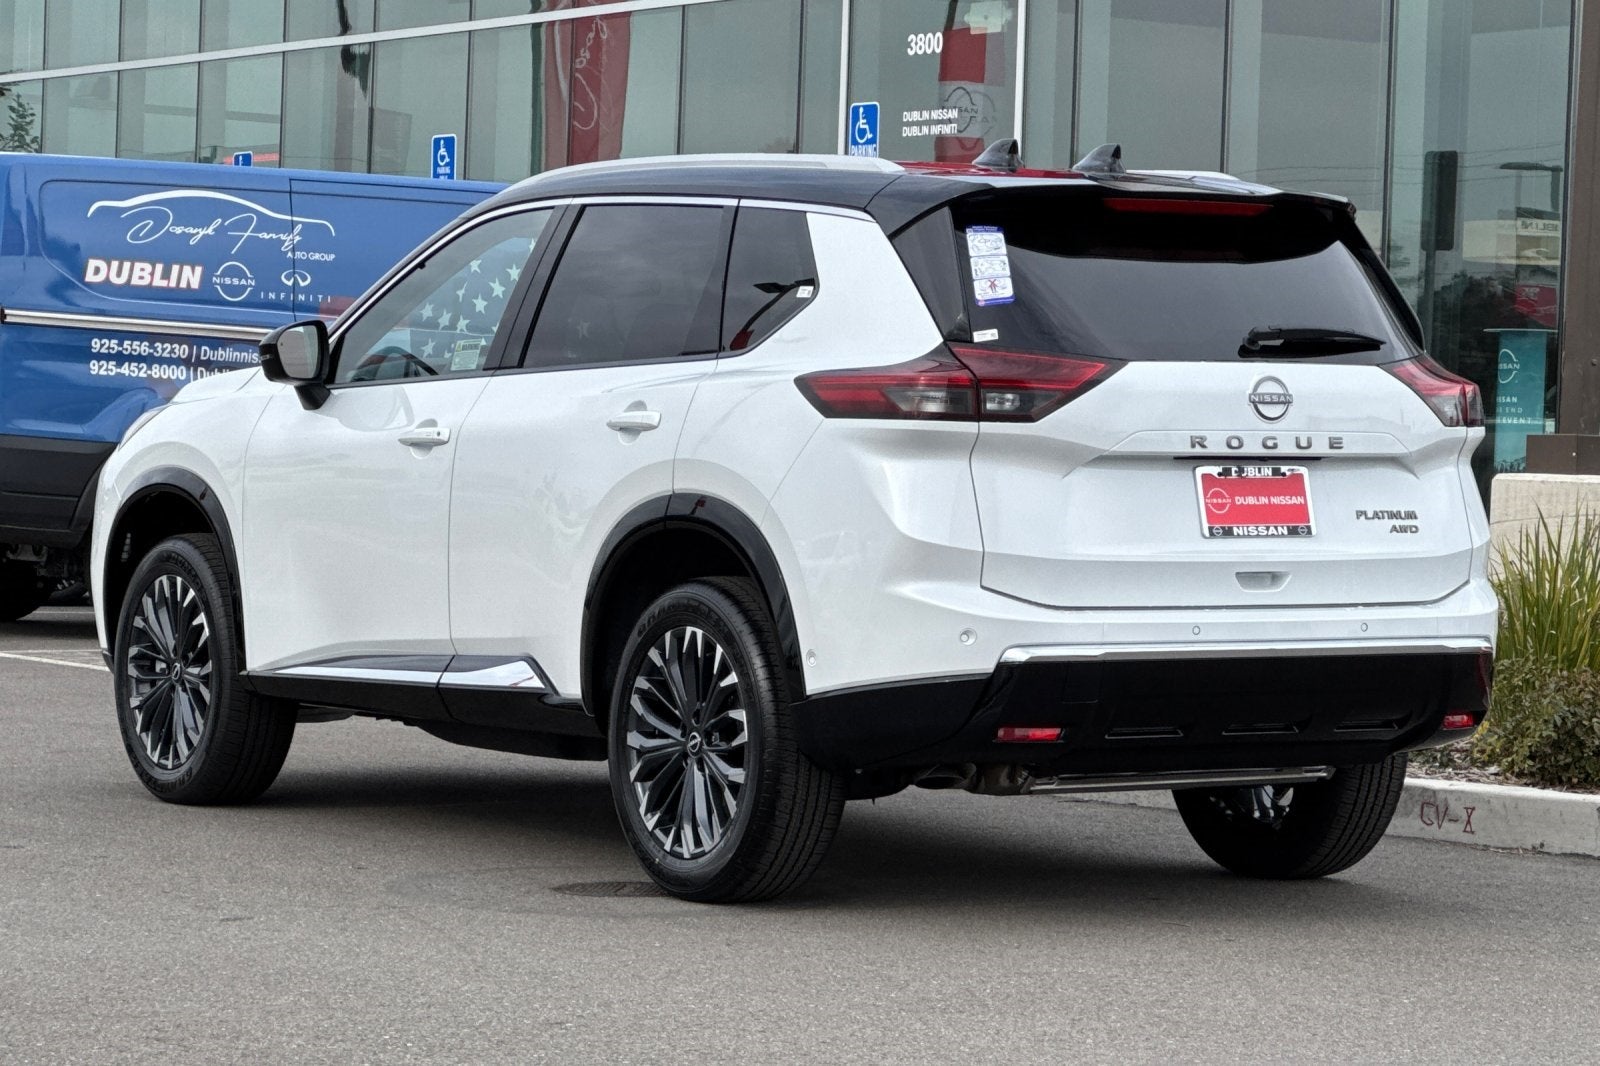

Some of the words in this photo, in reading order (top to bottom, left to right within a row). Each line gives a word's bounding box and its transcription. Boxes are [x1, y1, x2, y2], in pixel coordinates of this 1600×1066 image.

[907, 31, 943, 56] 3800
[902, 110, 930, 122] DUBLIN
[930, 108, 959, 120] NISSAN
[902, 125, 929, 137] DUBLIN
[930, 123, 958, 136] INFINITI
[308, 252, 336, 262] GROUP
[84, 258, 203, 289] DUBLIN
[212, 276, 256, 287] NISSAN
[260, 291, 332, 303] INFINITI
[91, 338, 189, 359] 925-556-3230
[89, 360, 187, 381] 925-452-8000
[1250, 394, 1293, 402] NISSAN
[1190, 435, 1344, 450] ROGUE
[1235, 496, 1269, 505] DUBLIN
[1270, 496, 1305, 505] NISSAN
[1355, 510, 1418, 520] PLATINUM
[1232, 526, 1288, 536] NISSAN
[1389, 524, 1419, 534] AWD
